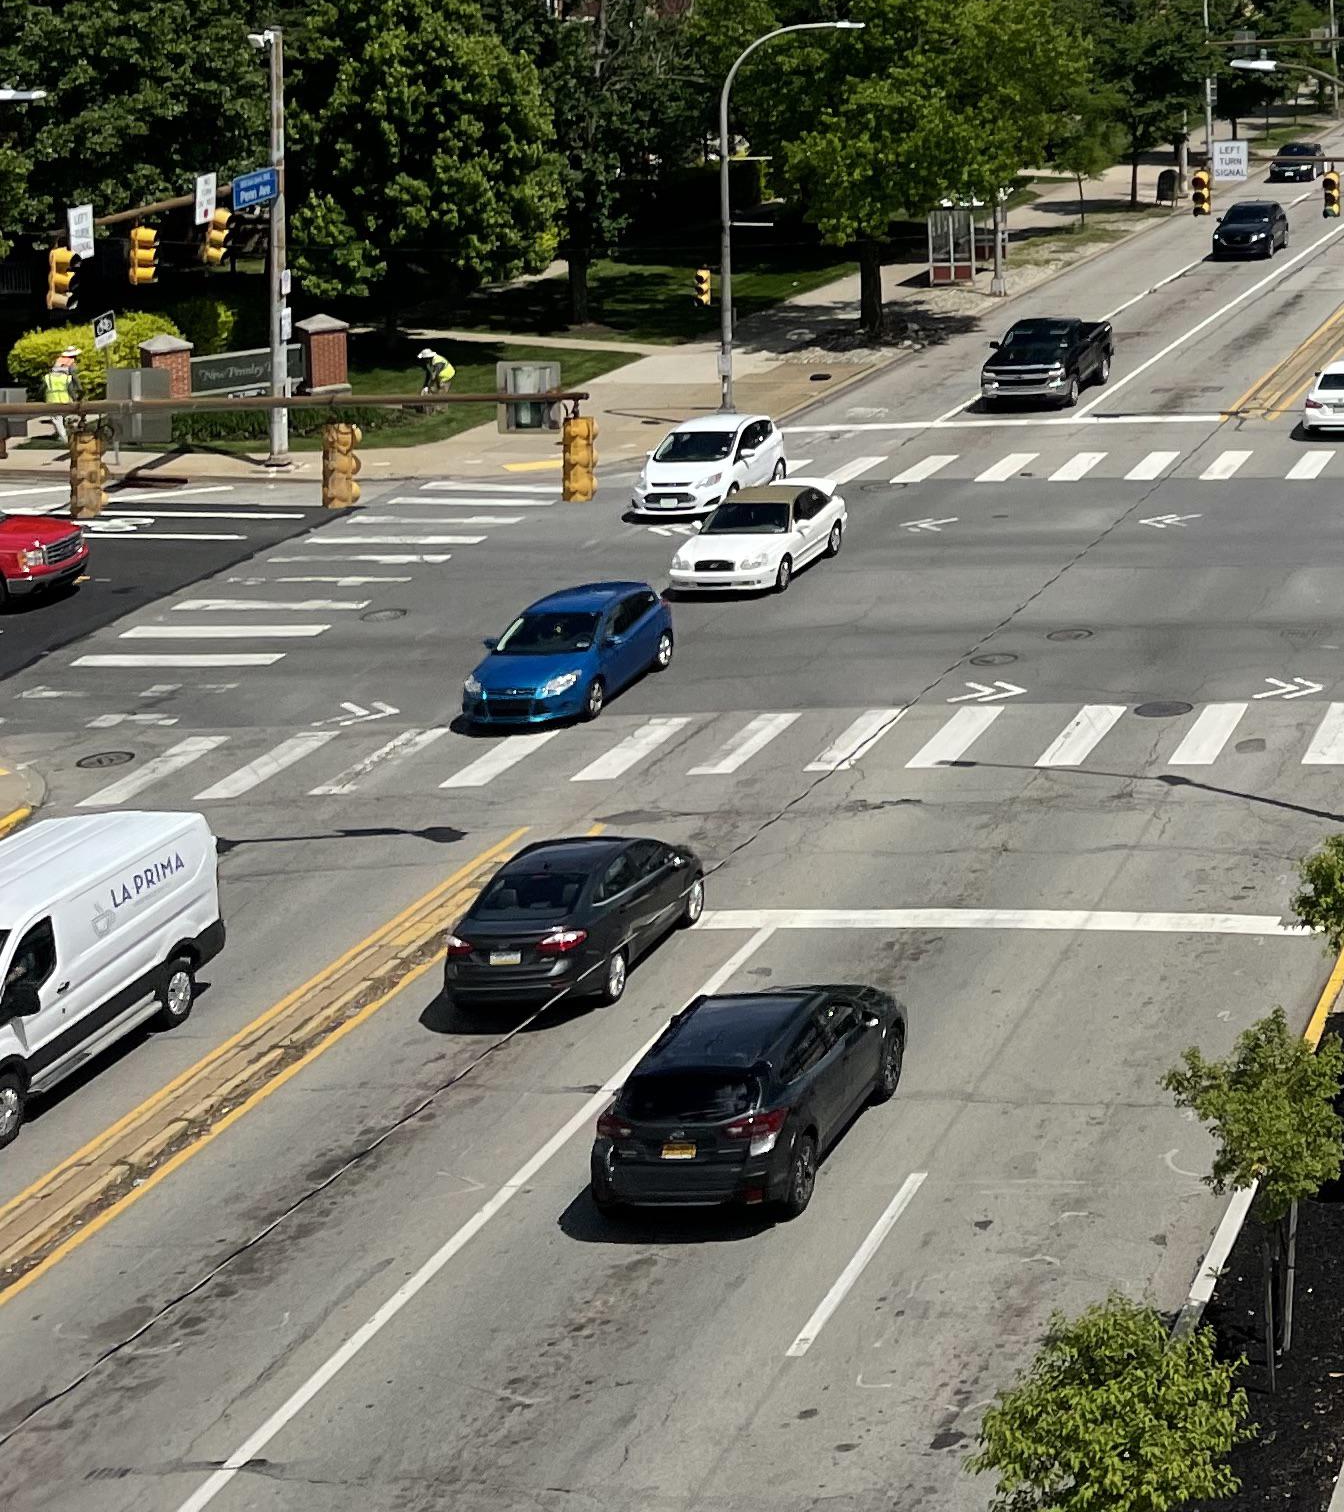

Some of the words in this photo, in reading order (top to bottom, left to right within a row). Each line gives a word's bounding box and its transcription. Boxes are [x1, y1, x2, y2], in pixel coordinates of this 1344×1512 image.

[1219, 146, 1240, 155] LEFT
[1219, 157, 1242, 166] TURN
[1215, 168, 1247, 177] SIGNAL
[110, 883, 132, 908] LA
[133, 852, 185, 895] PRIMA
